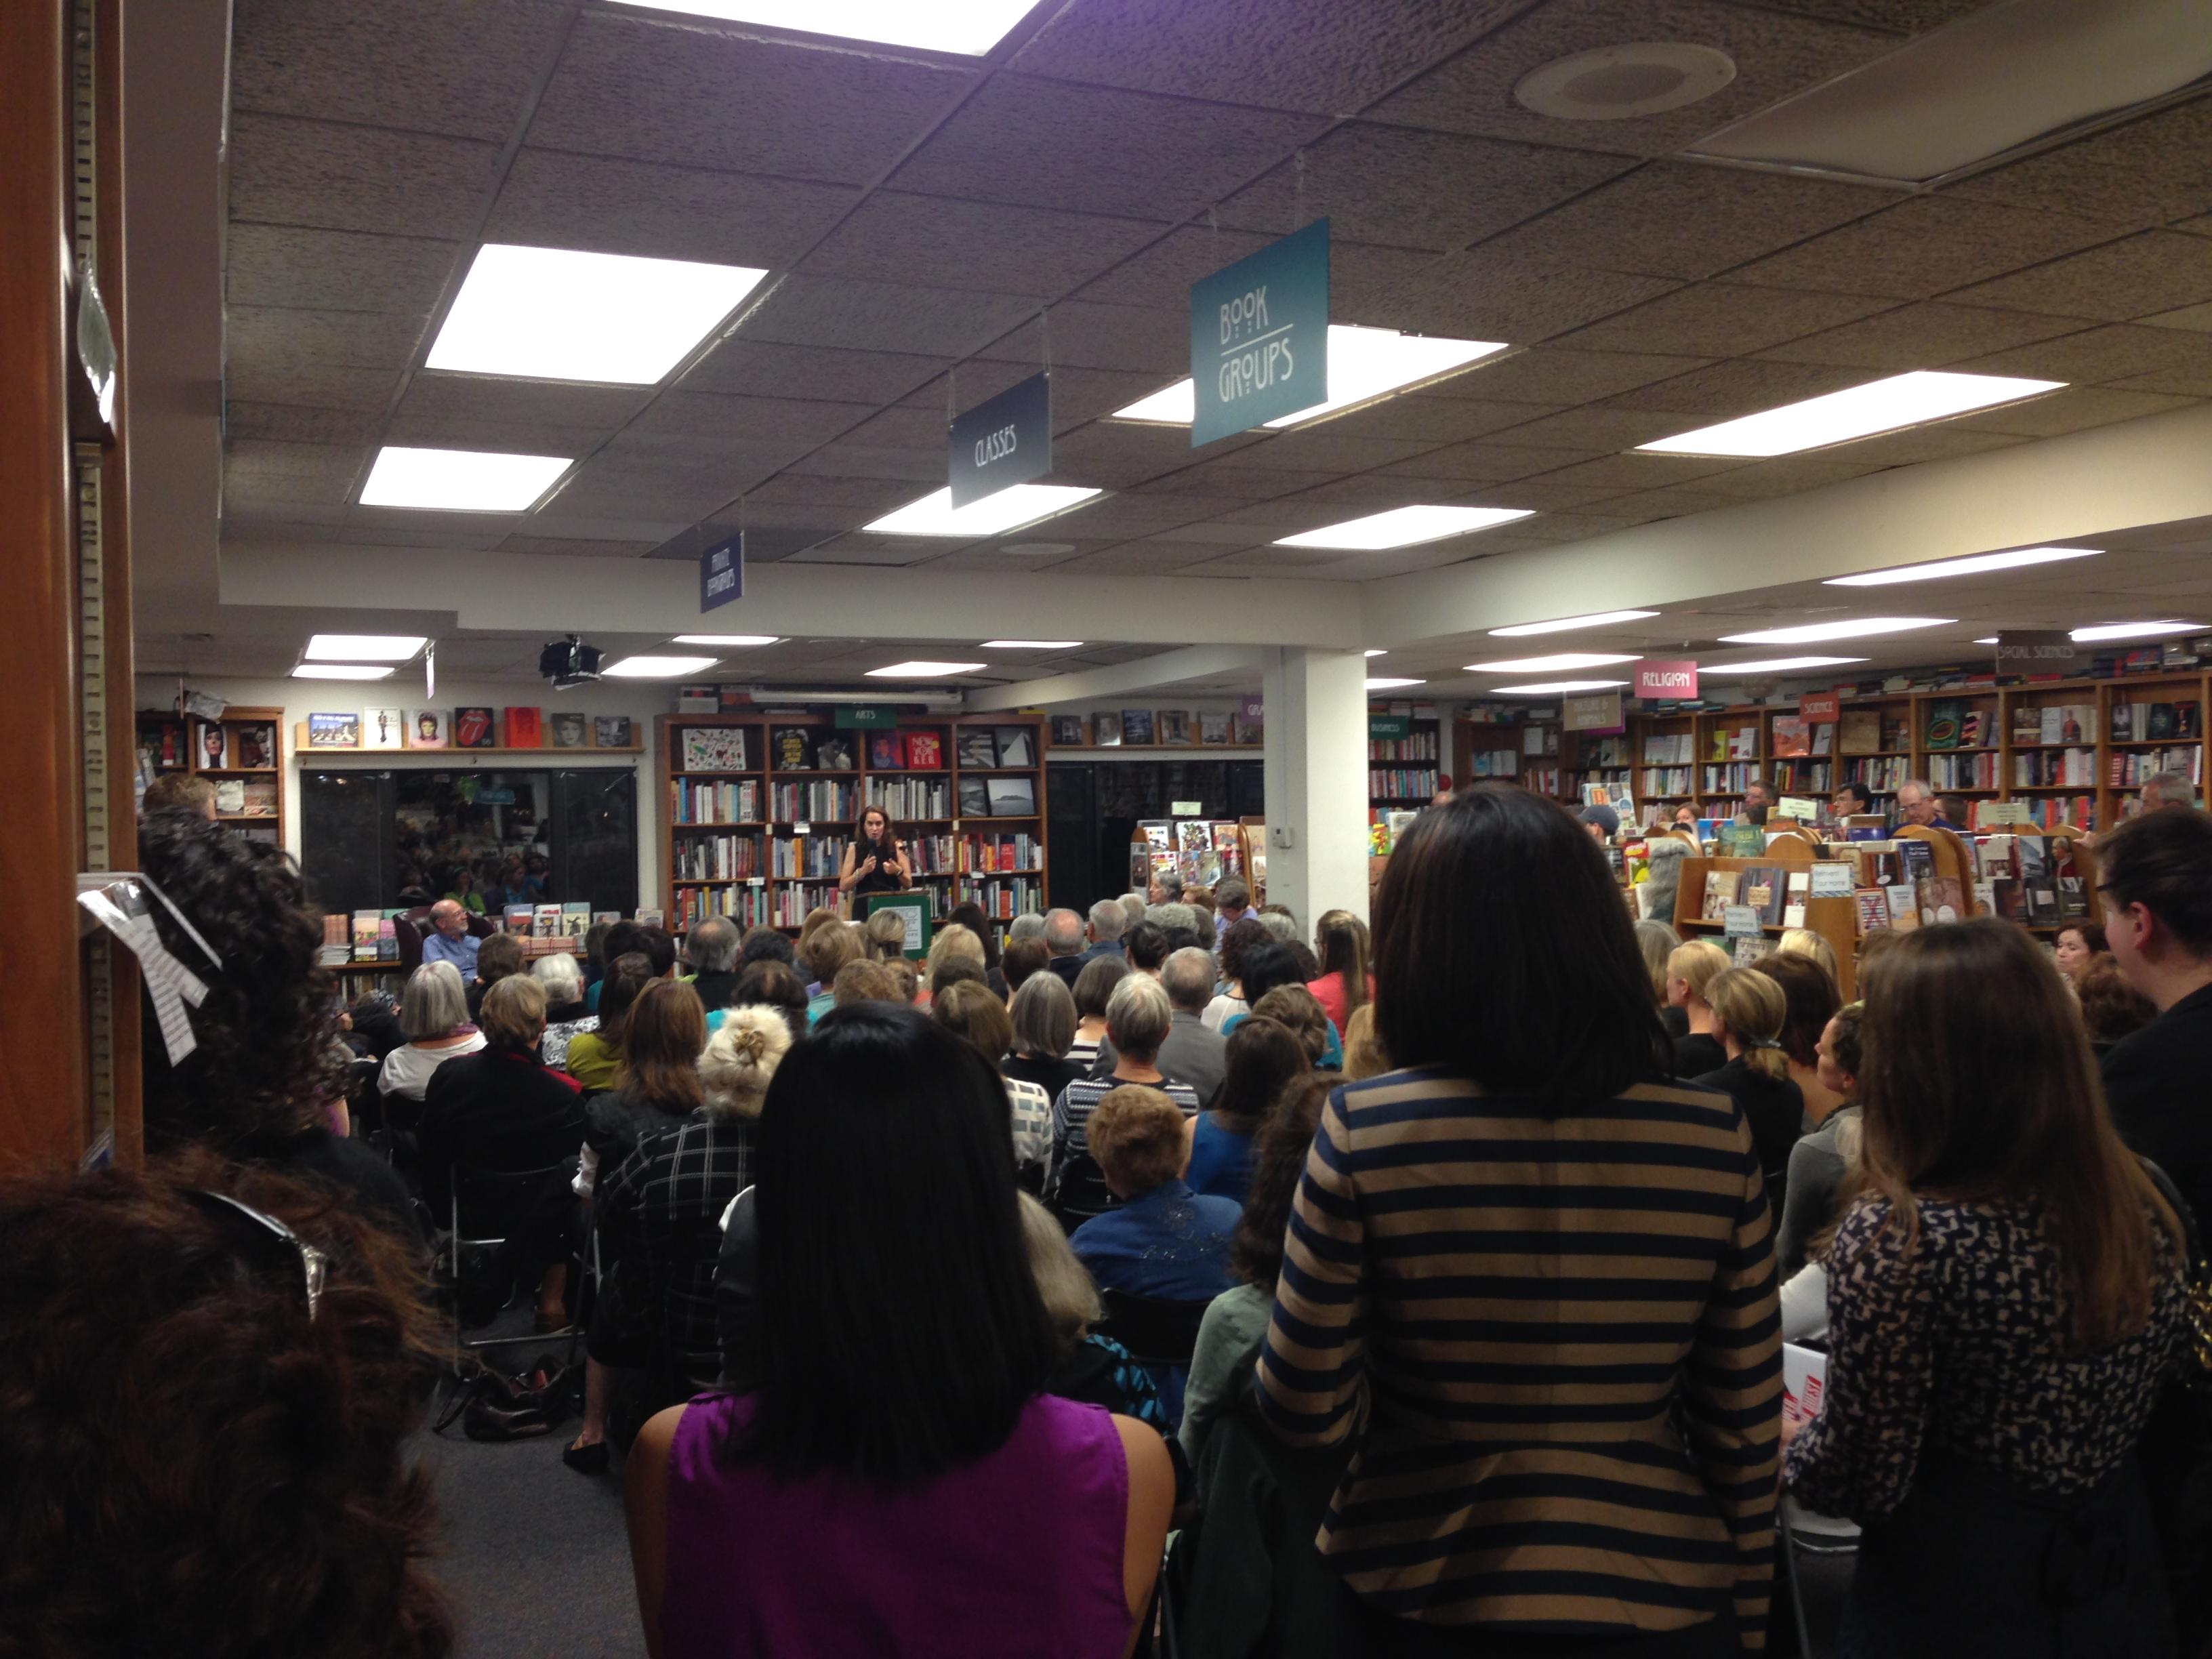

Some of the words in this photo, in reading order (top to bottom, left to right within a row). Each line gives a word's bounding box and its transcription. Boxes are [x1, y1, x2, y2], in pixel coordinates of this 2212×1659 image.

[1220, 285, 1269, 345] BOOK
[1218, 337, 1294, 403] GROUPS
[975, 424, 1017, 468] CLASSES
[1642, 672, 1691, 687] RELIGION
[855, 710, 876, 720] ARTS
[1804, 701, 1833, 714] SCIENCE
[1371, 723, 1400, 733] BUSINESS
